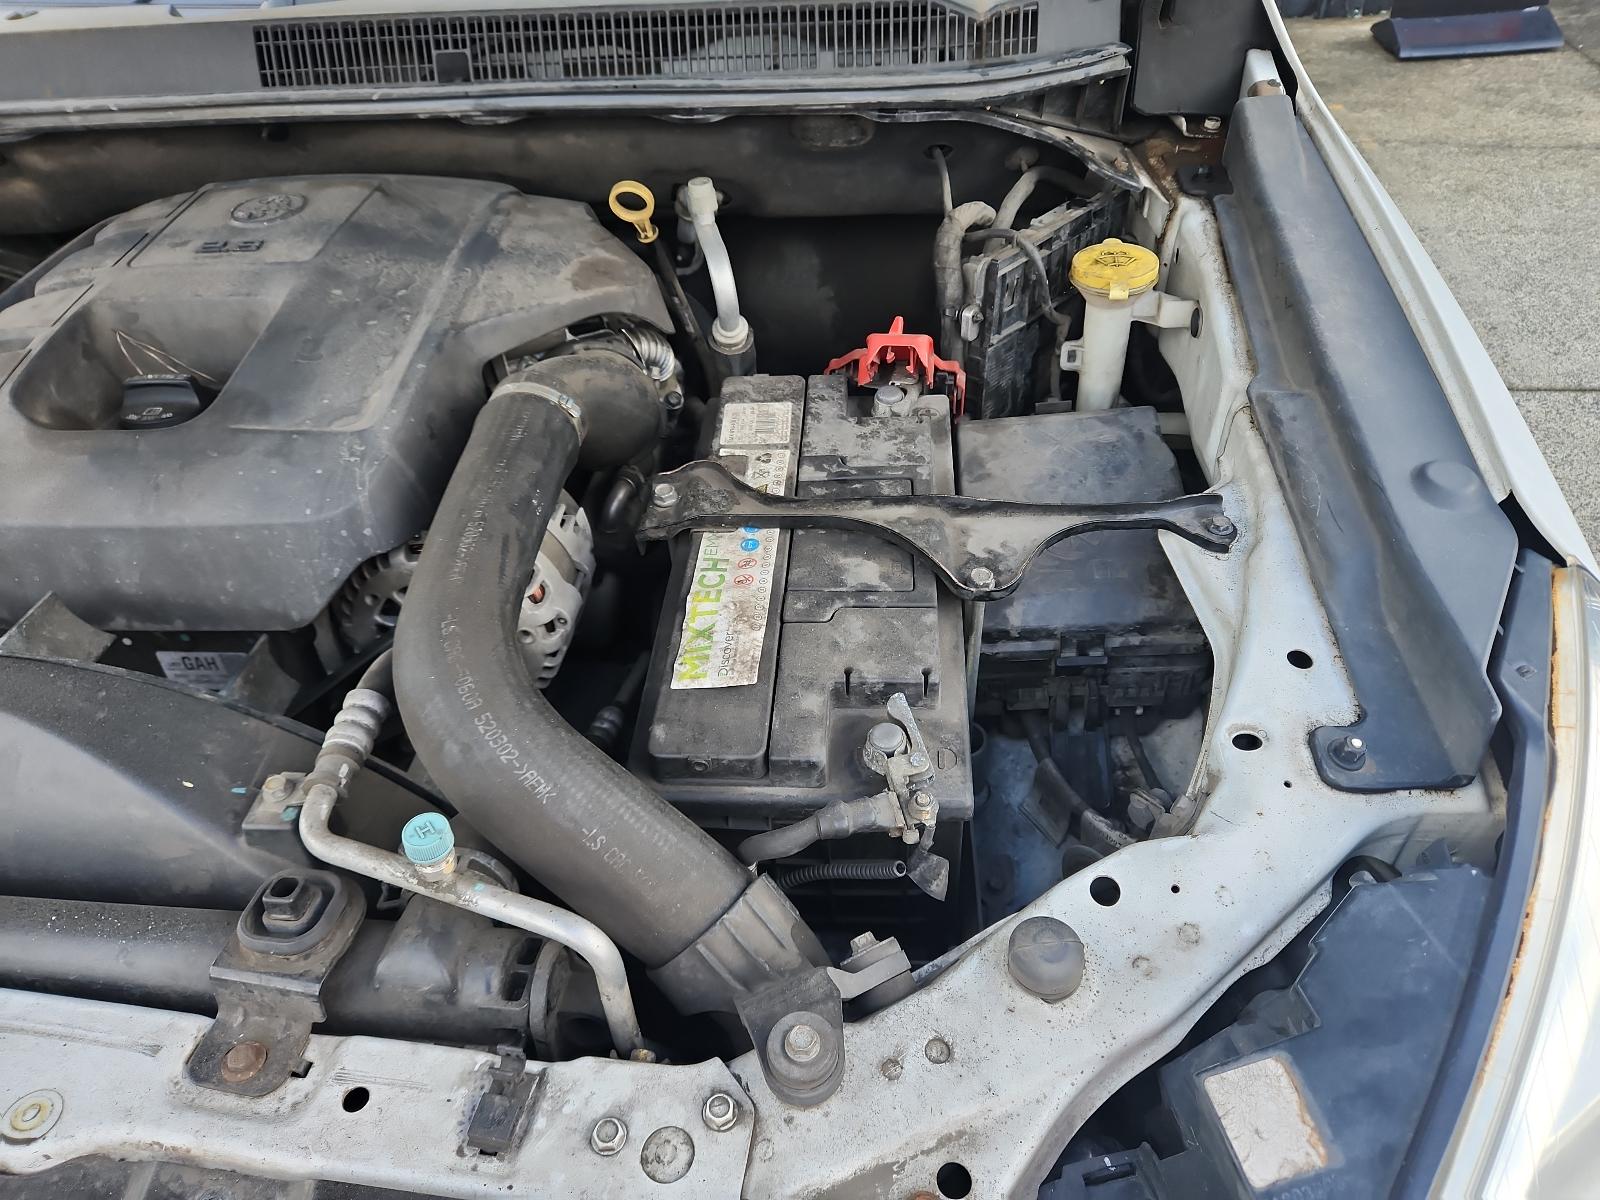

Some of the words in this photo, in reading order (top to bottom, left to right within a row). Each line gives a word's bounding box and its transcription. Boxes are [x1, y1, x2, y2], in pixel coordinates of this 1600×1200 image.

[678, 557, 730, 681] MIXTECH
[181, 656, 220, 671] GAH
[718, 632, 735, 678] Discover
[415, 821, 436, 839] H
